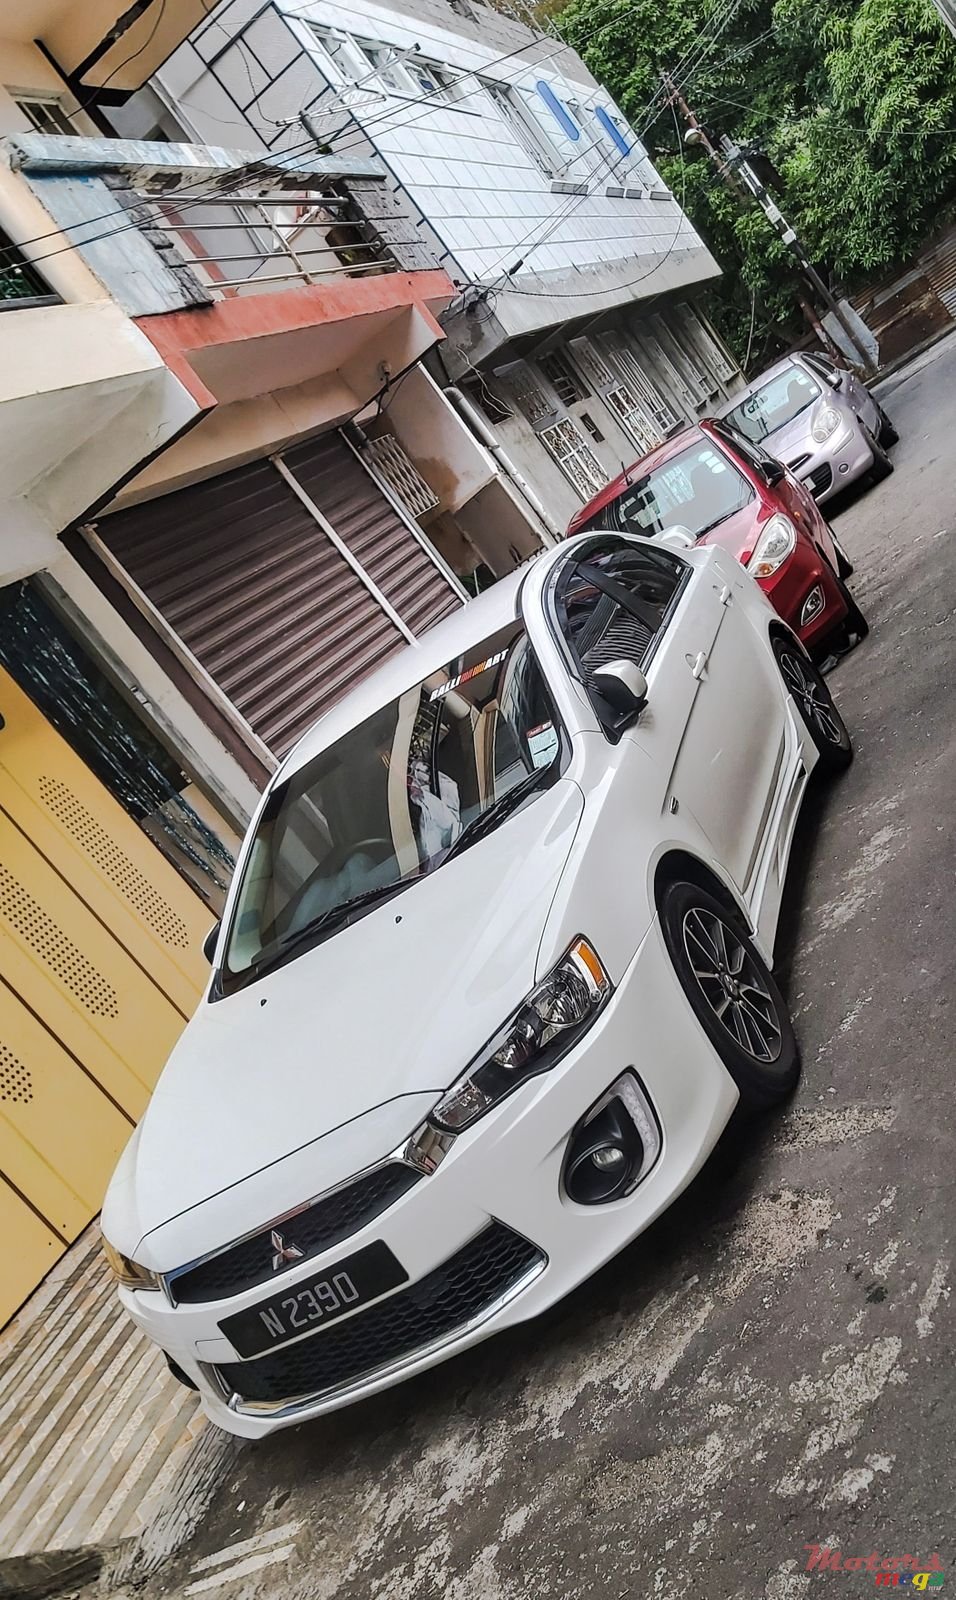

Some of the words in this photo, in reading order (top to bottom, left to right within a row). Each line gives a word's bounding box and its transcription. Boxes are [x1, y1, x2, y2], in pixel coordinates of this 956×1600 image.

[429, 674, 462, 703] RALLI
[484, 648, 509, 670] ART
[259, 1307, 286, 1338] N
[282, 1271, 360, 1328] 2390
